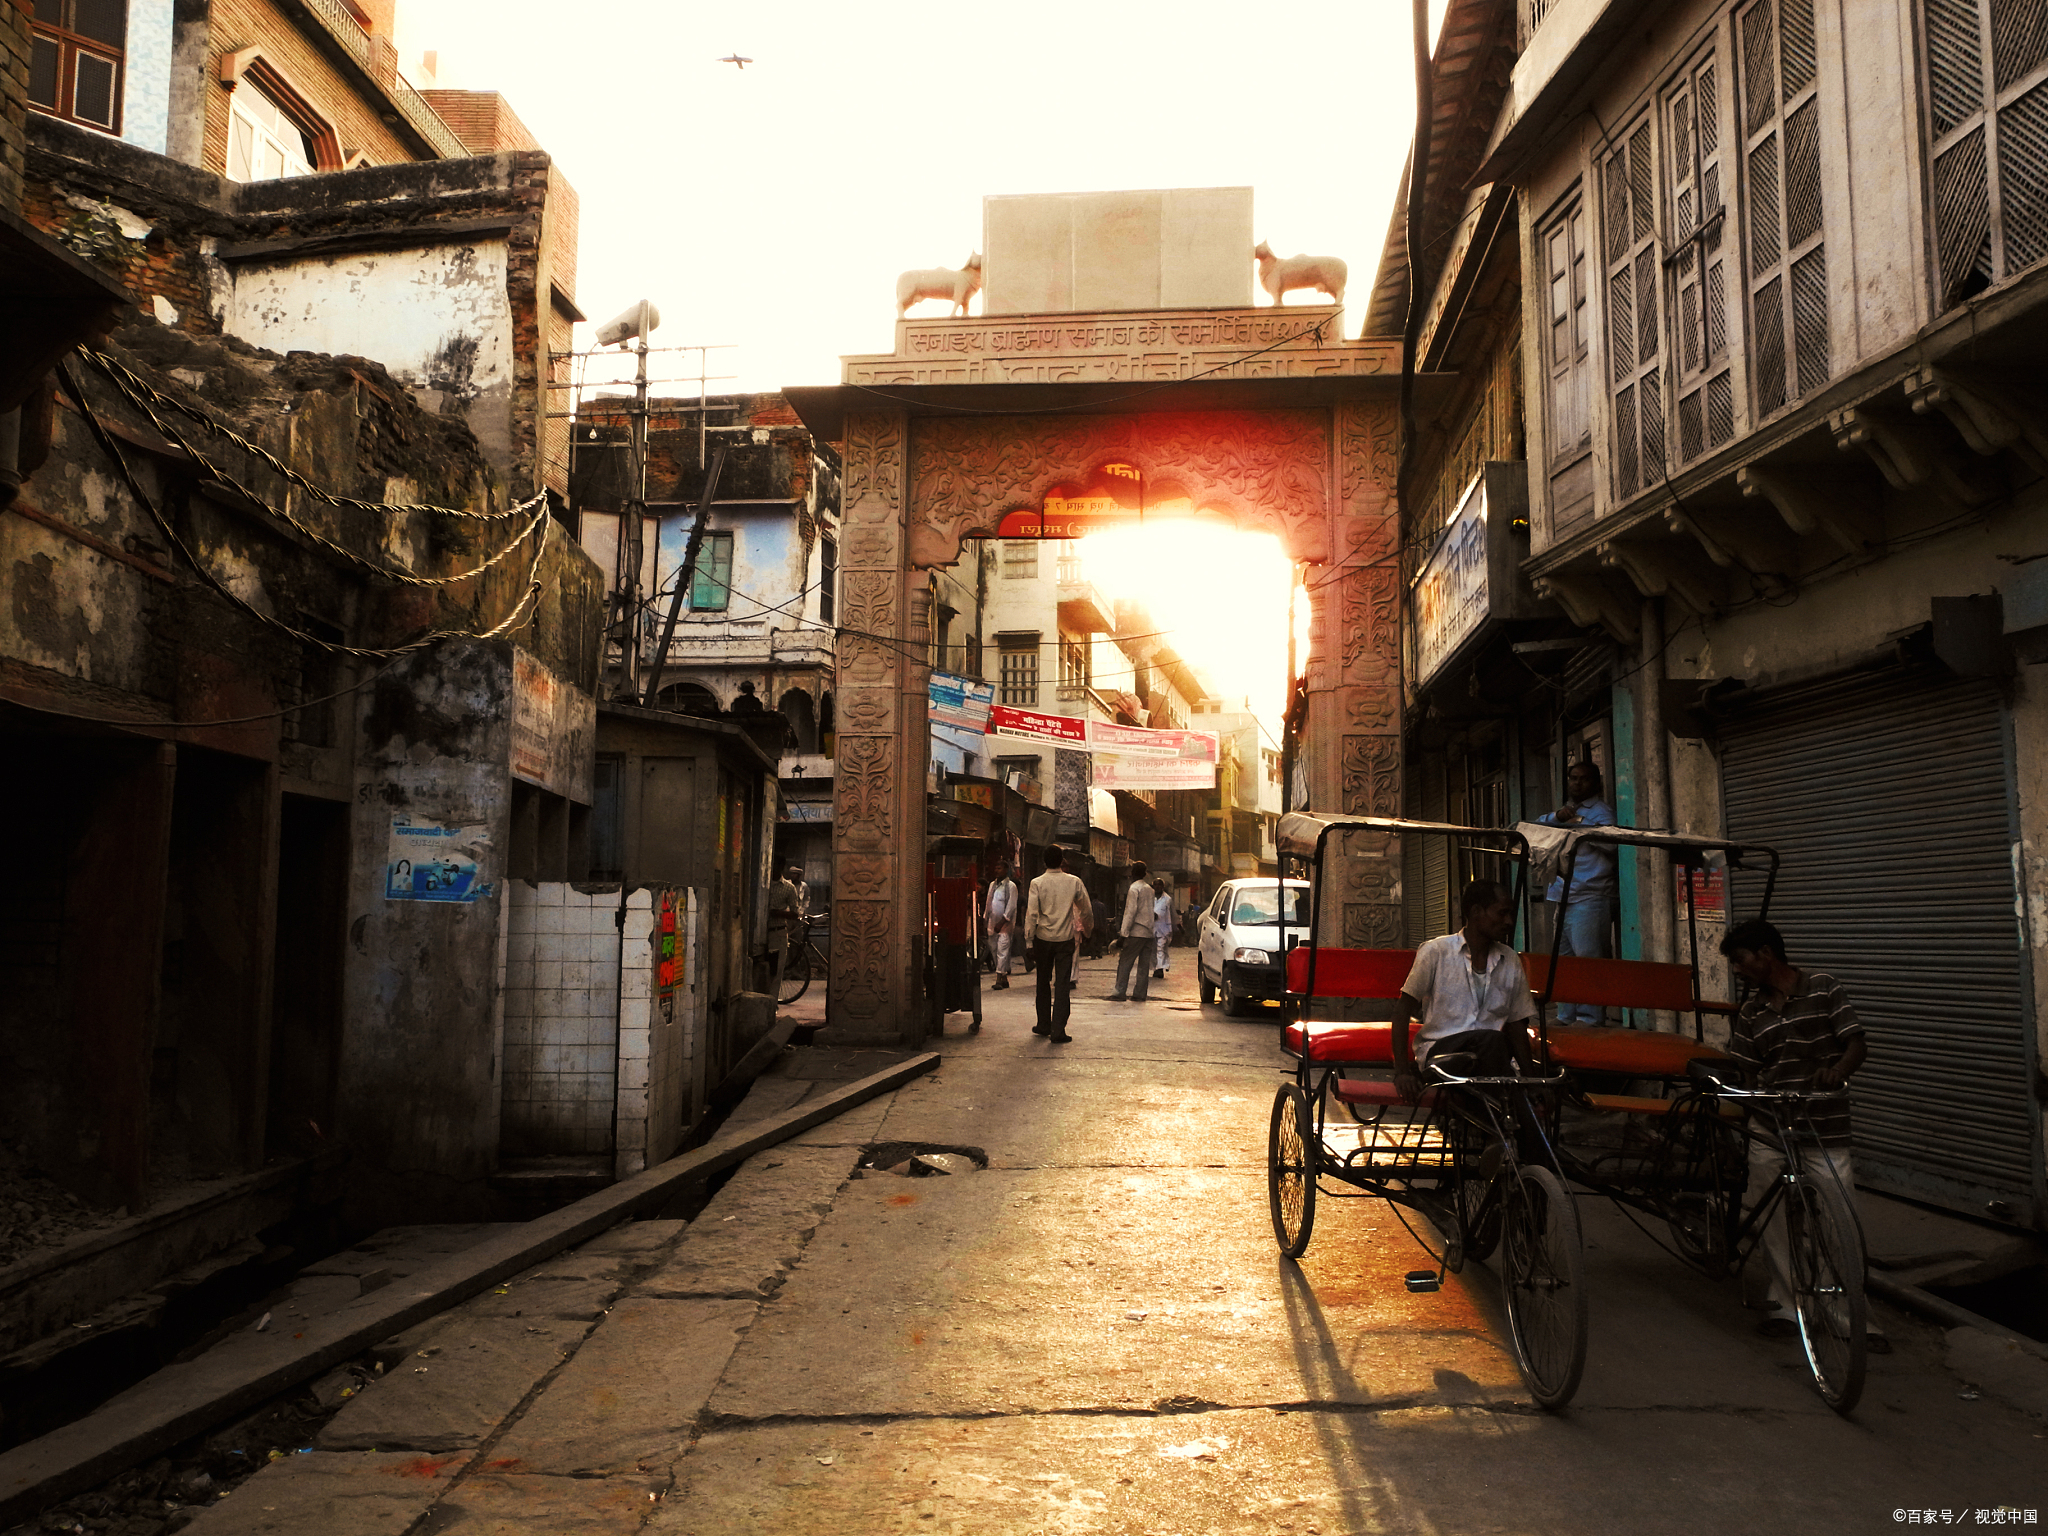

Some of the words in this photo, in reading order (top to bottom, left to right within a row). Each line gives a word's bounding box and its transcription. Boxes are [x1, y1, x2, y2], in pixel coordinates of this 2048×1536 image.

[991, 327, 1062, 352] ब्राह्मण
[1065, 325, 1134, 348] समाज
[1137, 320, 1167, 347] को
[1170, 315, 1254, 346] समर्पित
[396, 826, 442, 836] समाजवादी
